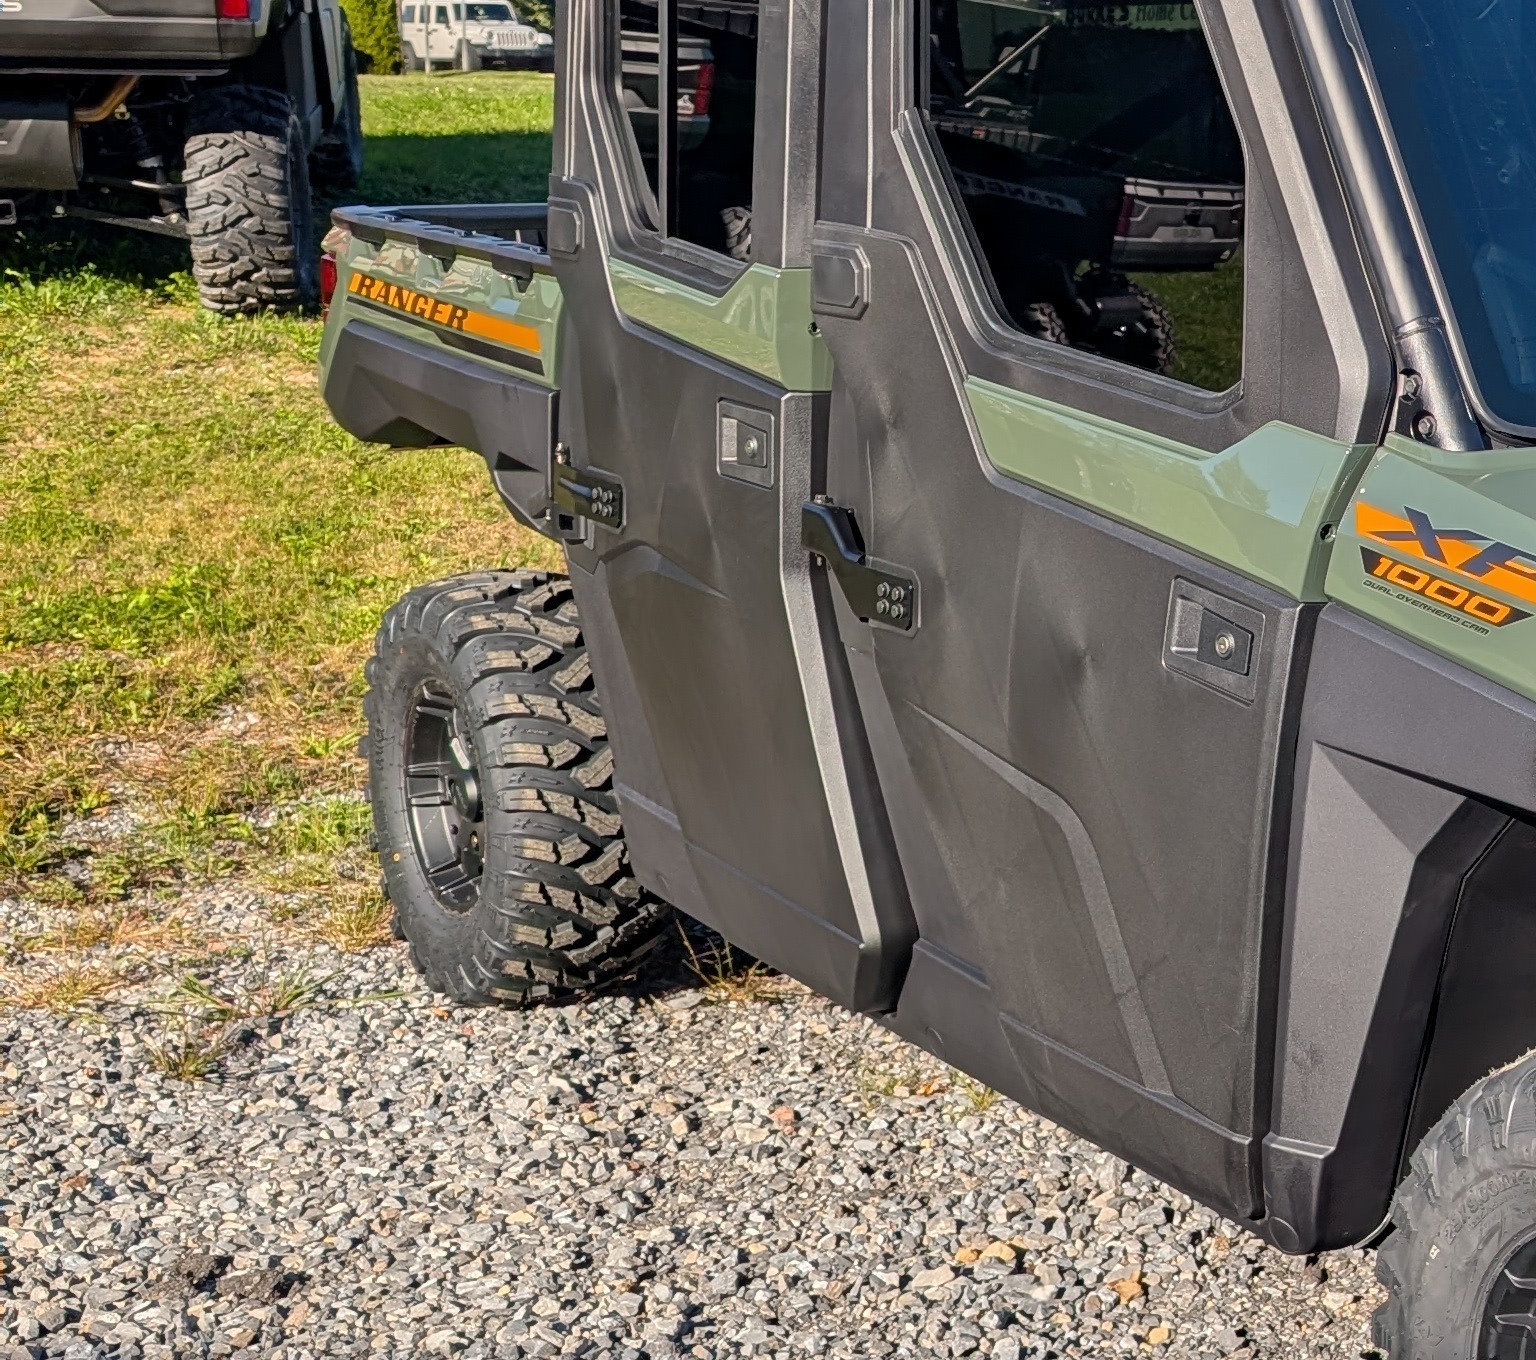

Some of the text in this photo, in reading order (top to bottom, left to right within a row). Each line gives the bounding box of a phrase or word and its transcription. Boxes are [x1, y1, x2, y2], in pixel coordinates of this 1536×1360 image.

[354, 273, 470, 333] RANGER
[1362, 579, 1490, 636] DUAL OVERHEAD CAM
[1372, 556, 1512, 625] 1000
